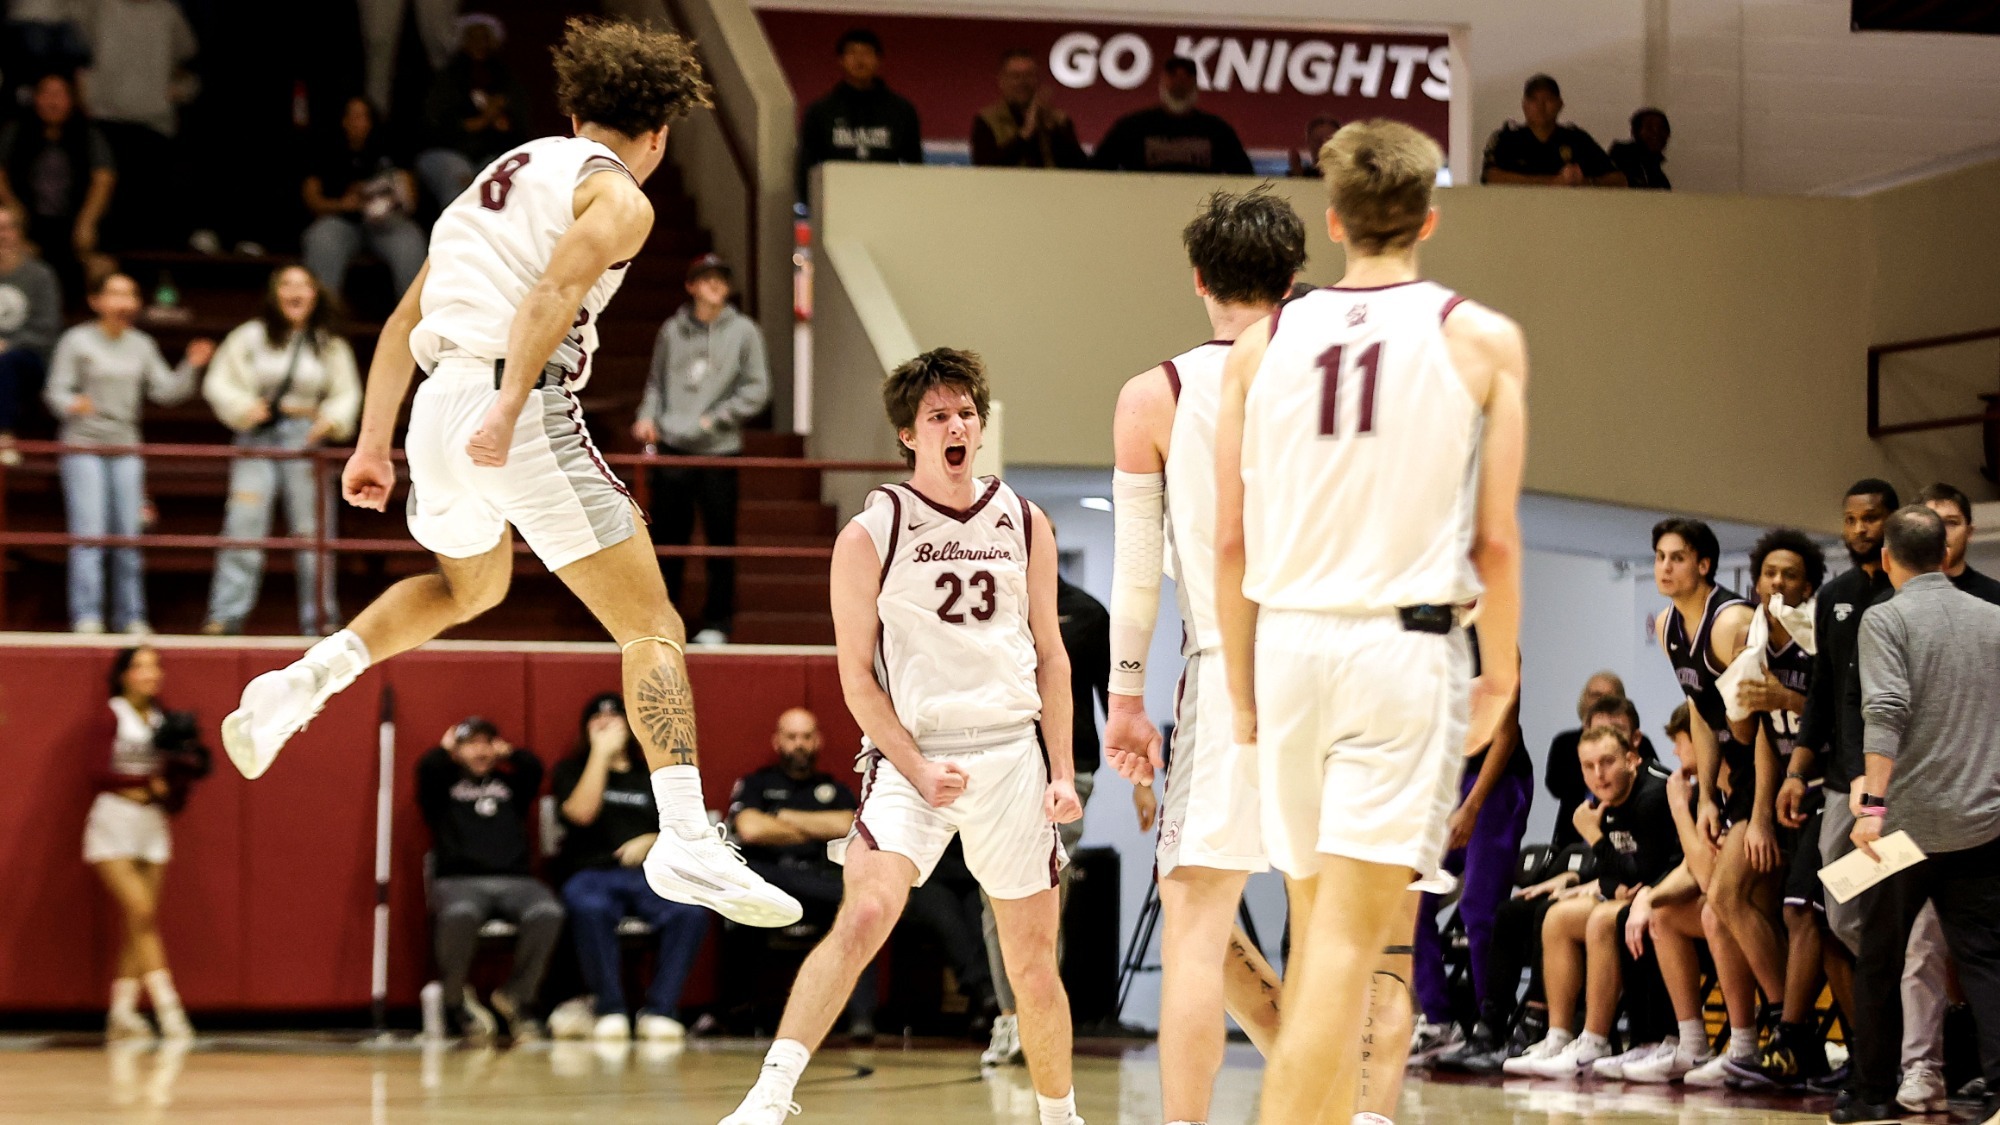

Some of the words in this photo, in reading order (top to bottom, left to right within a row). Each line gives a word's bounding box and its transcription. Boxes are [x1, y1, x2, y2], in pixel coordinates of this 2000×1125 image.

[1049, 32, 1152, 90] GO
[1173, 36, 1451, 101] KNIGHTS
[480, 152, 531, 212] 8
[1313, 340, 1384, 438] 11
[913, 541, 1011, 563] Bellarmine
[935, 570, 996, 624] 23
